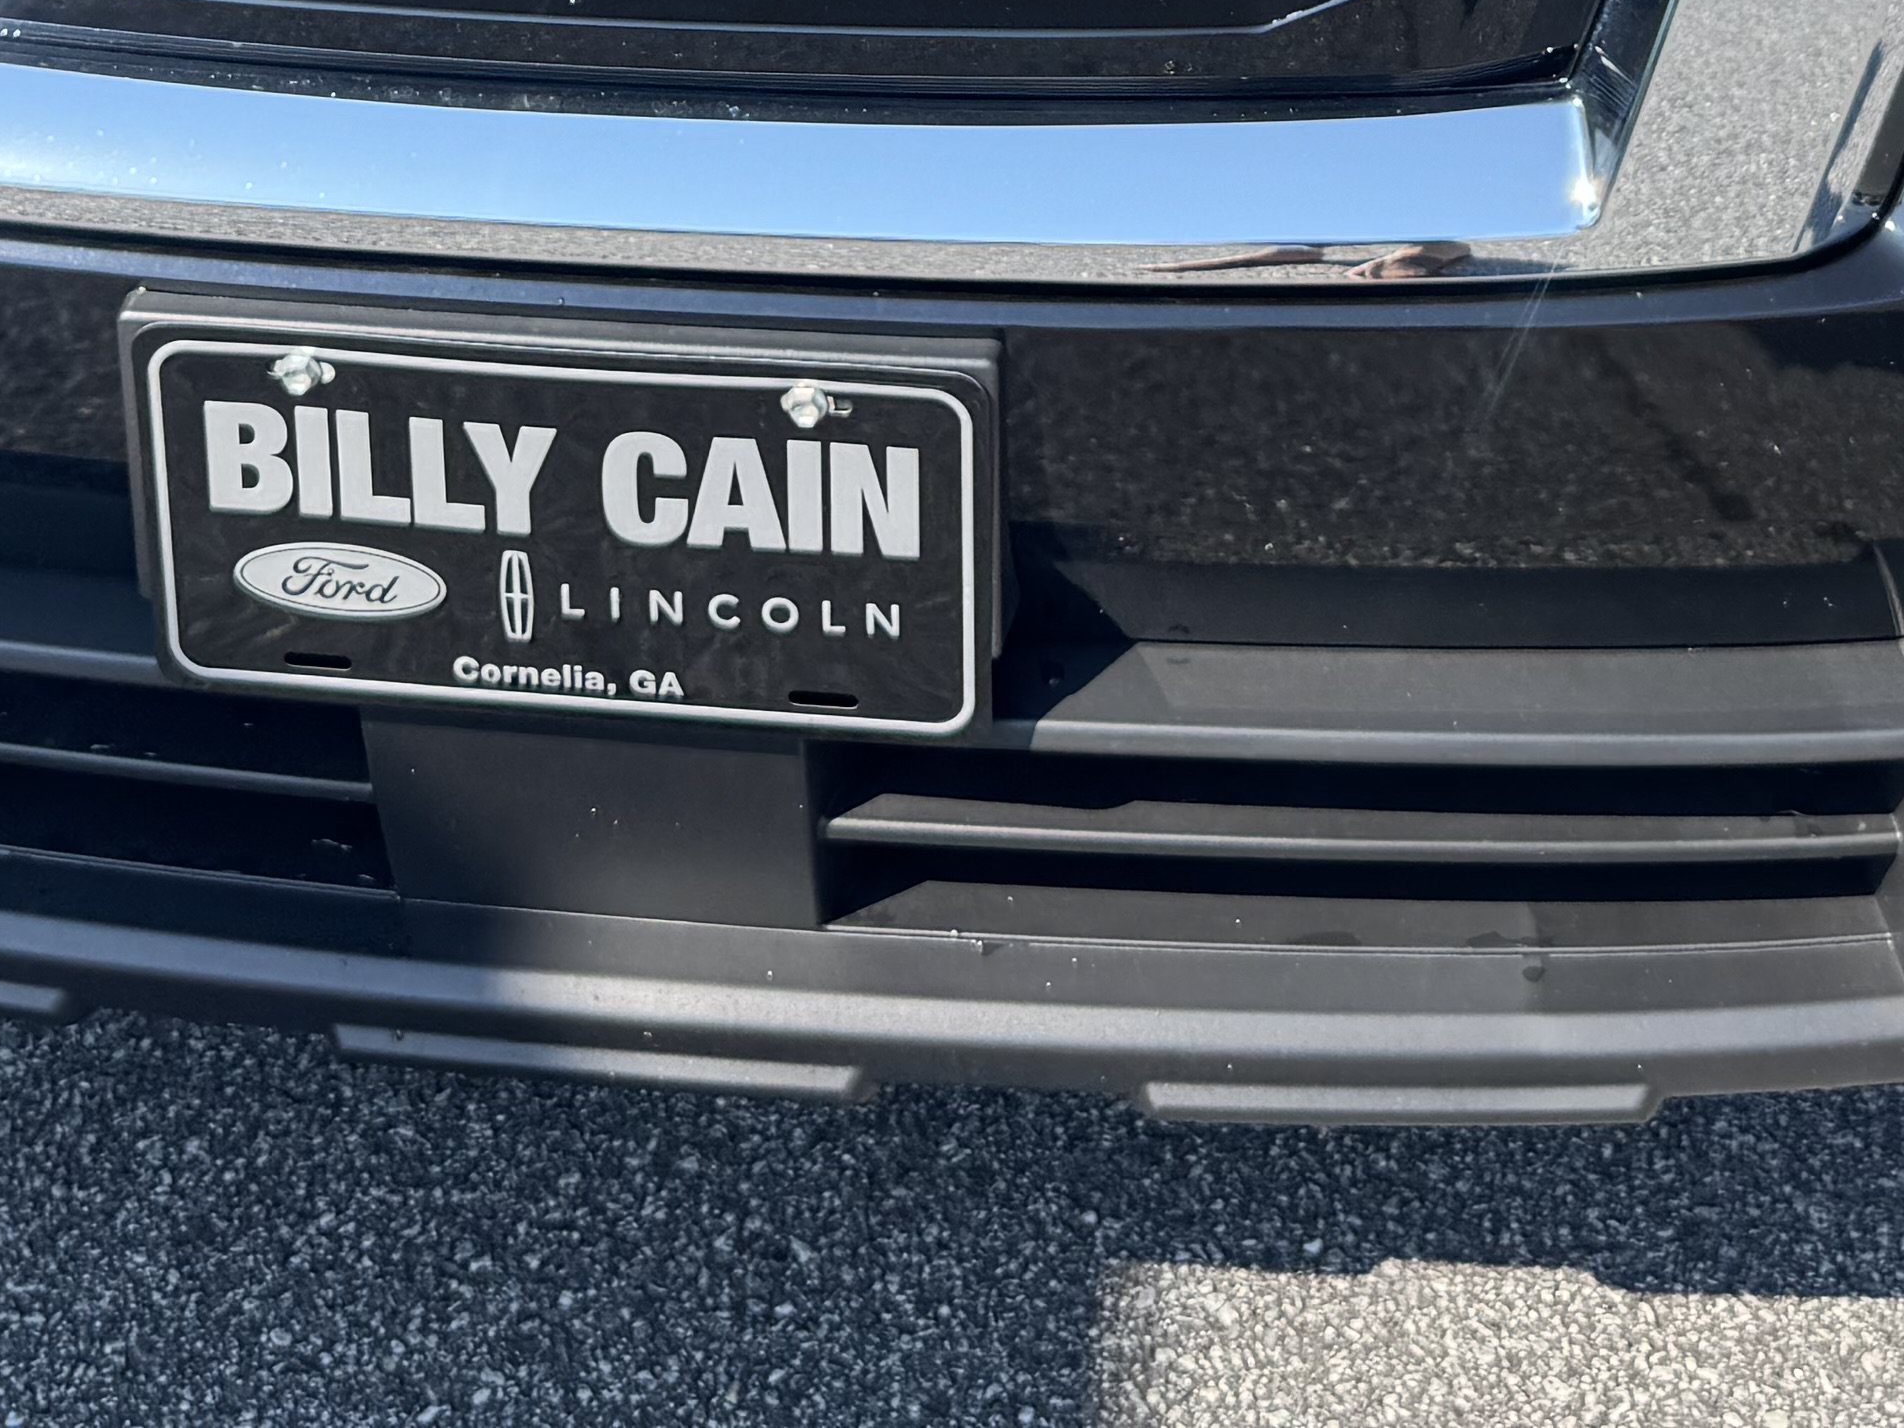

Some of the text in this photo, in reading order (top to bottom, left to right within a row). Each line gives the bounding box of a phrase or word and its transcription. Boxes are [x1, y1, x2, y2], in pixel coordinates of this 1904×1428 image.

[202, 400, 921, 560] BILLY CAIN
[280, 555, 399, 606] Ford
[560, 582, 902, 639] LINCOLN
[453, 655, 685, 698] Cornelia, GA
